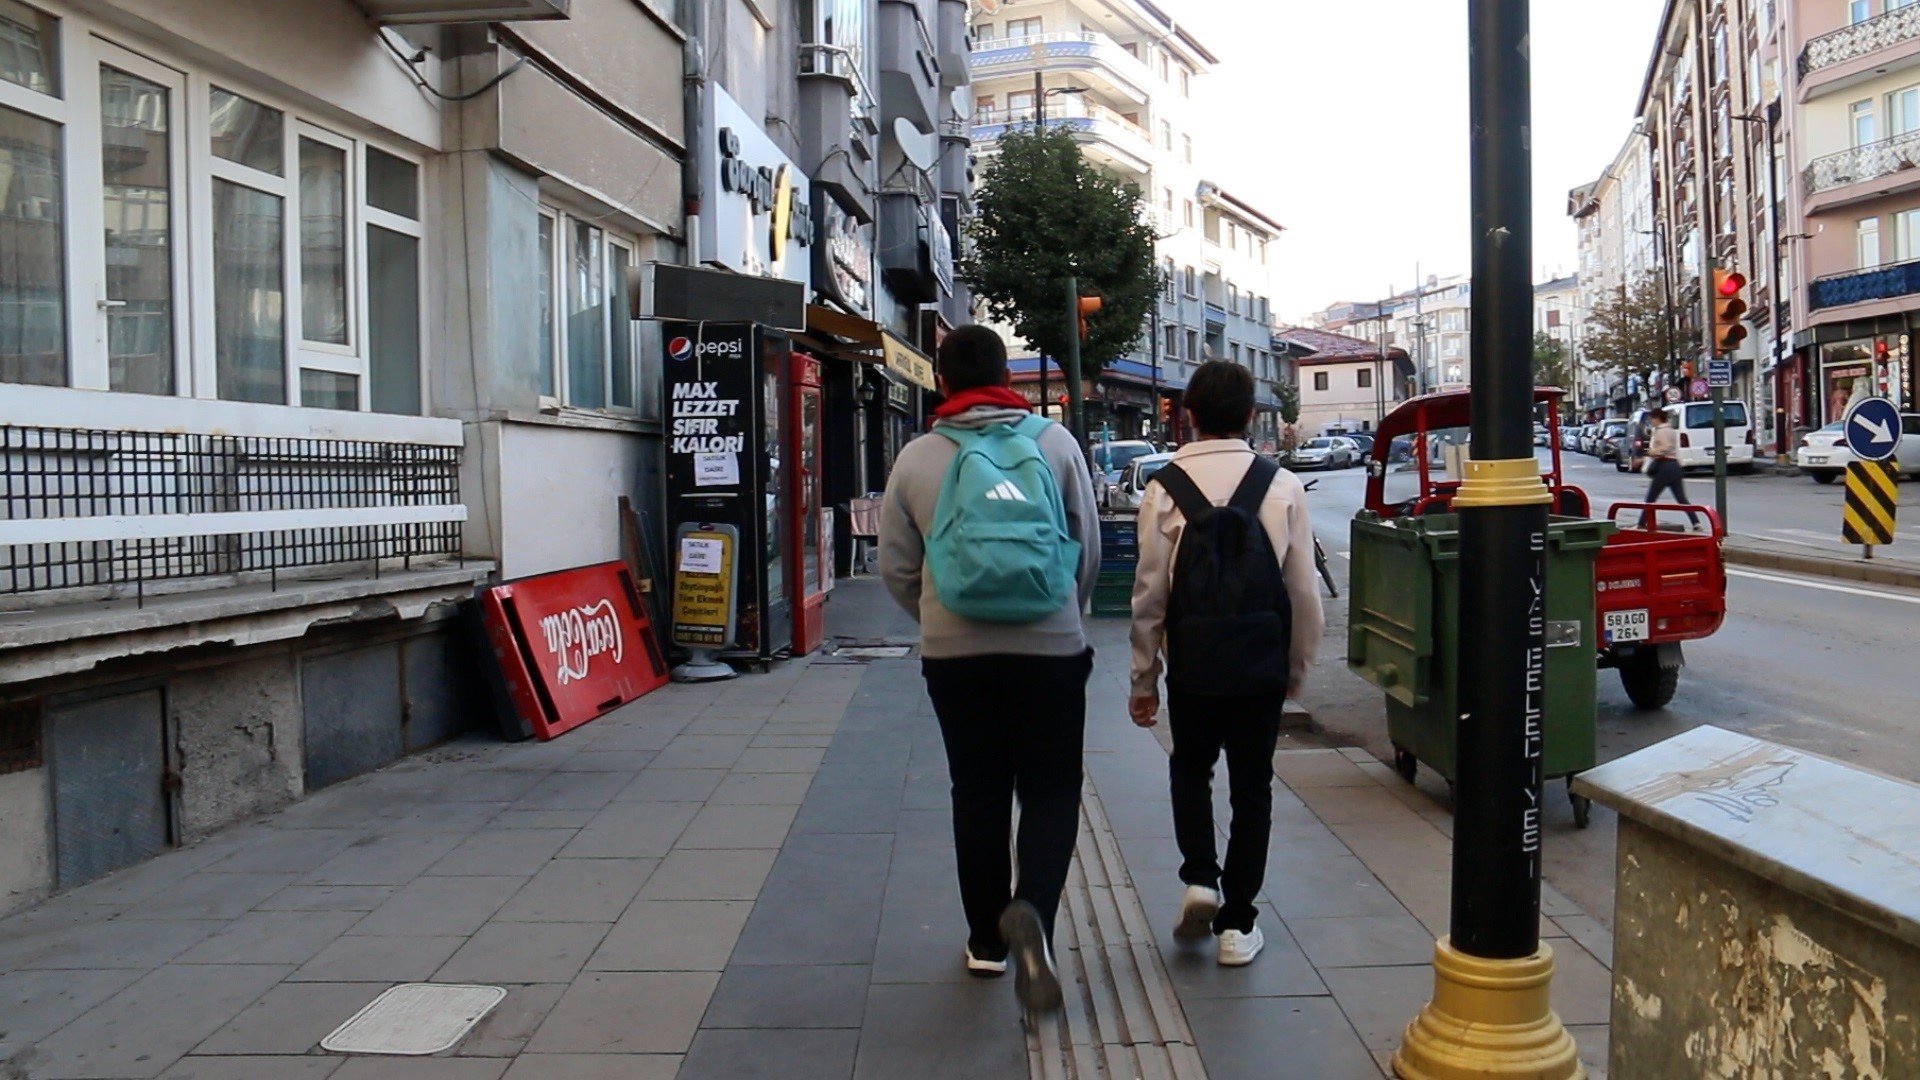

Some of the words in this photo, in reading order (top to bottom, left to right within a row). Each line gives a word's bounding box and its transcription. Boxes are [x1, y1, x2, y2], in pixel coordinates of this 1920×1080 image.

[695, 338, 742, 357] pepsi
[672, 382, 718, 399] MAX
[672, 400, 739, 417] LEZZET
[673, 419, 718, 435] SIFIR
[673, 432, 744, 453] KALORİ
[1617, 627, 1639, 640] 264
